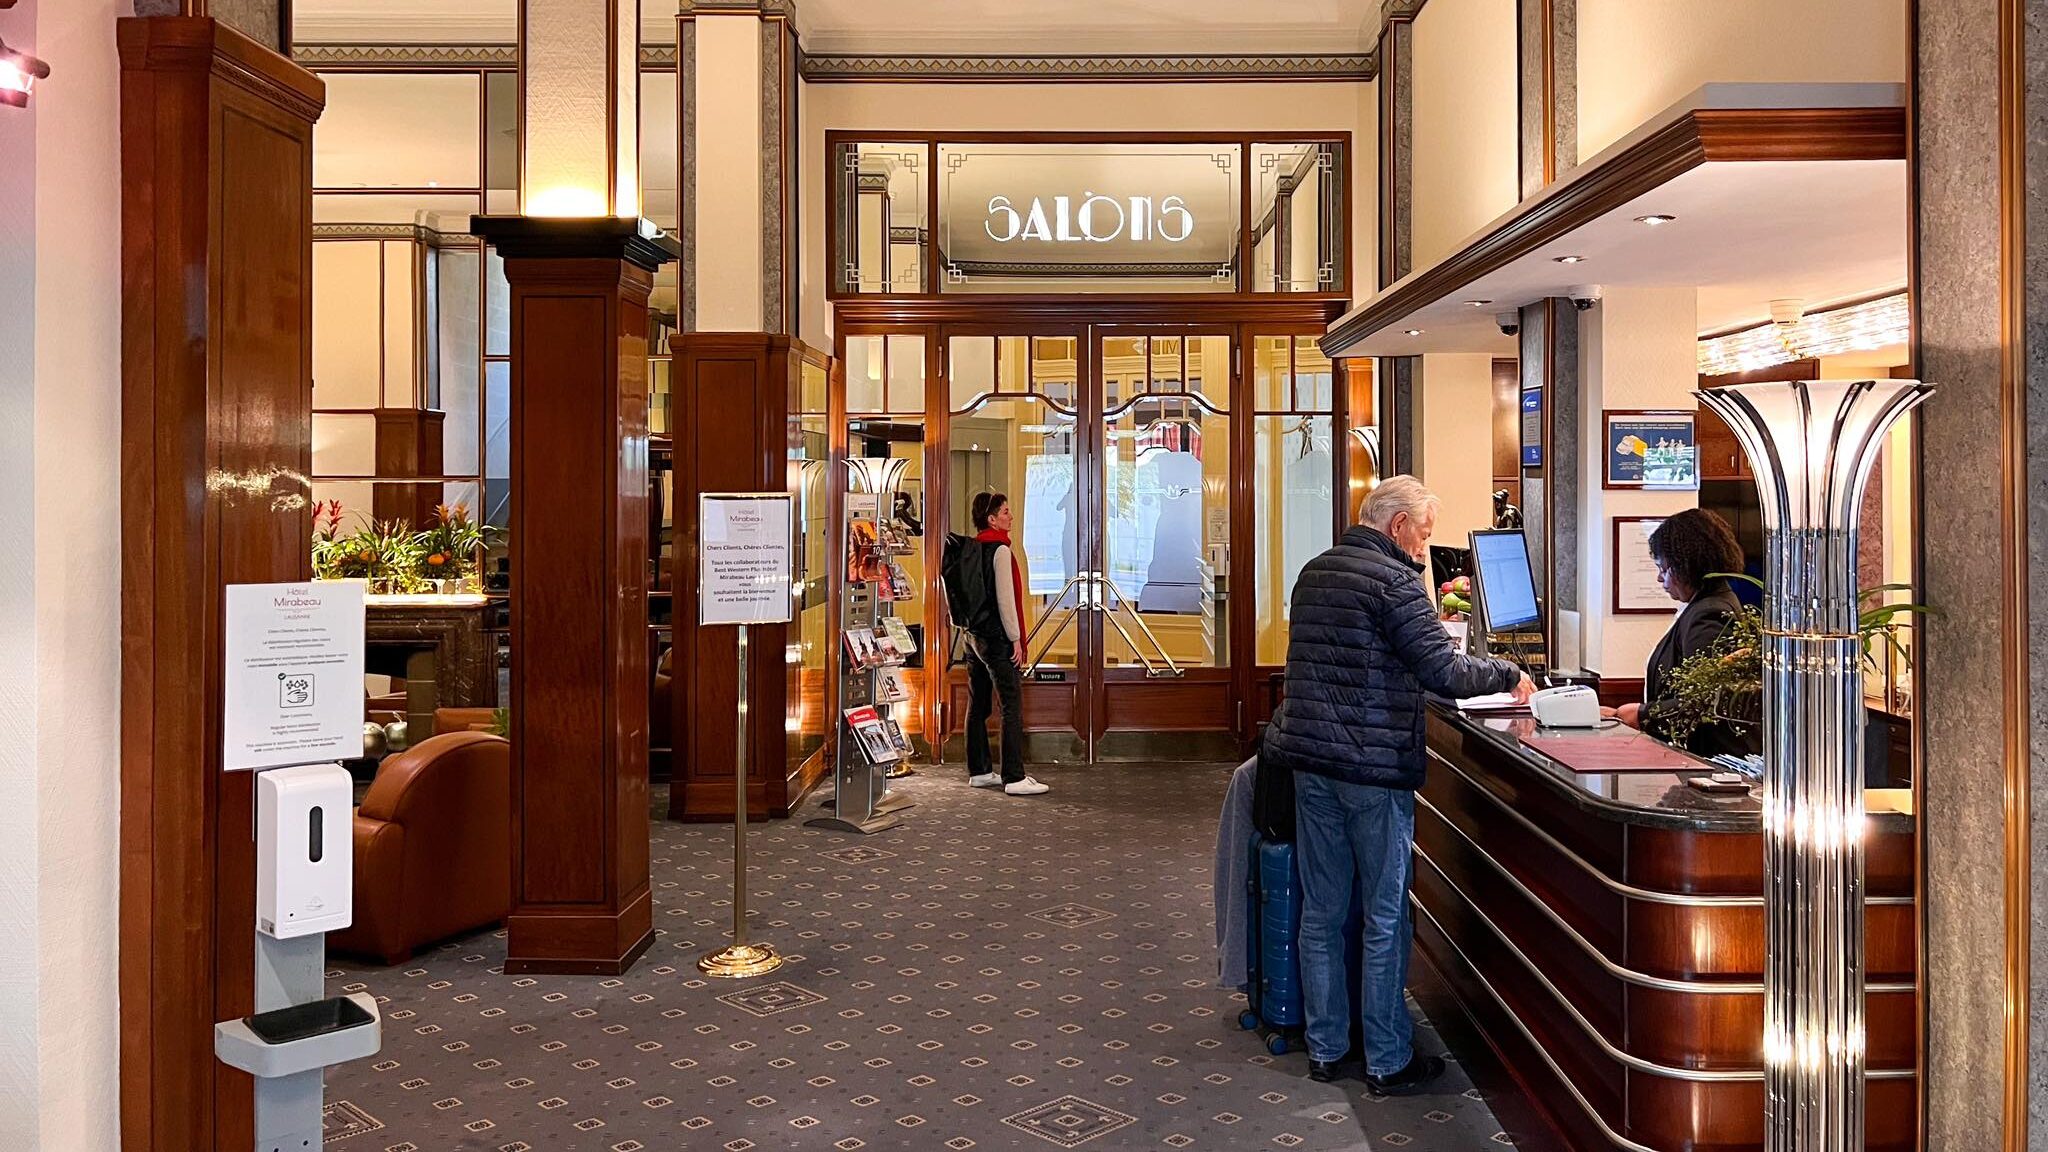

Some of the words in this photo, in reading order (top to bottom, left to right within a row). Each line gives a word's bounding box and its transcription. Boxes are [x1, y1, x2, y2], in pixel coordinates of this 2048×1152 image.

[872, 546, 881, 555] 10
[286, 587, 309, 596] Hôtel
[273, 597, 321, 607] Mirabeau
